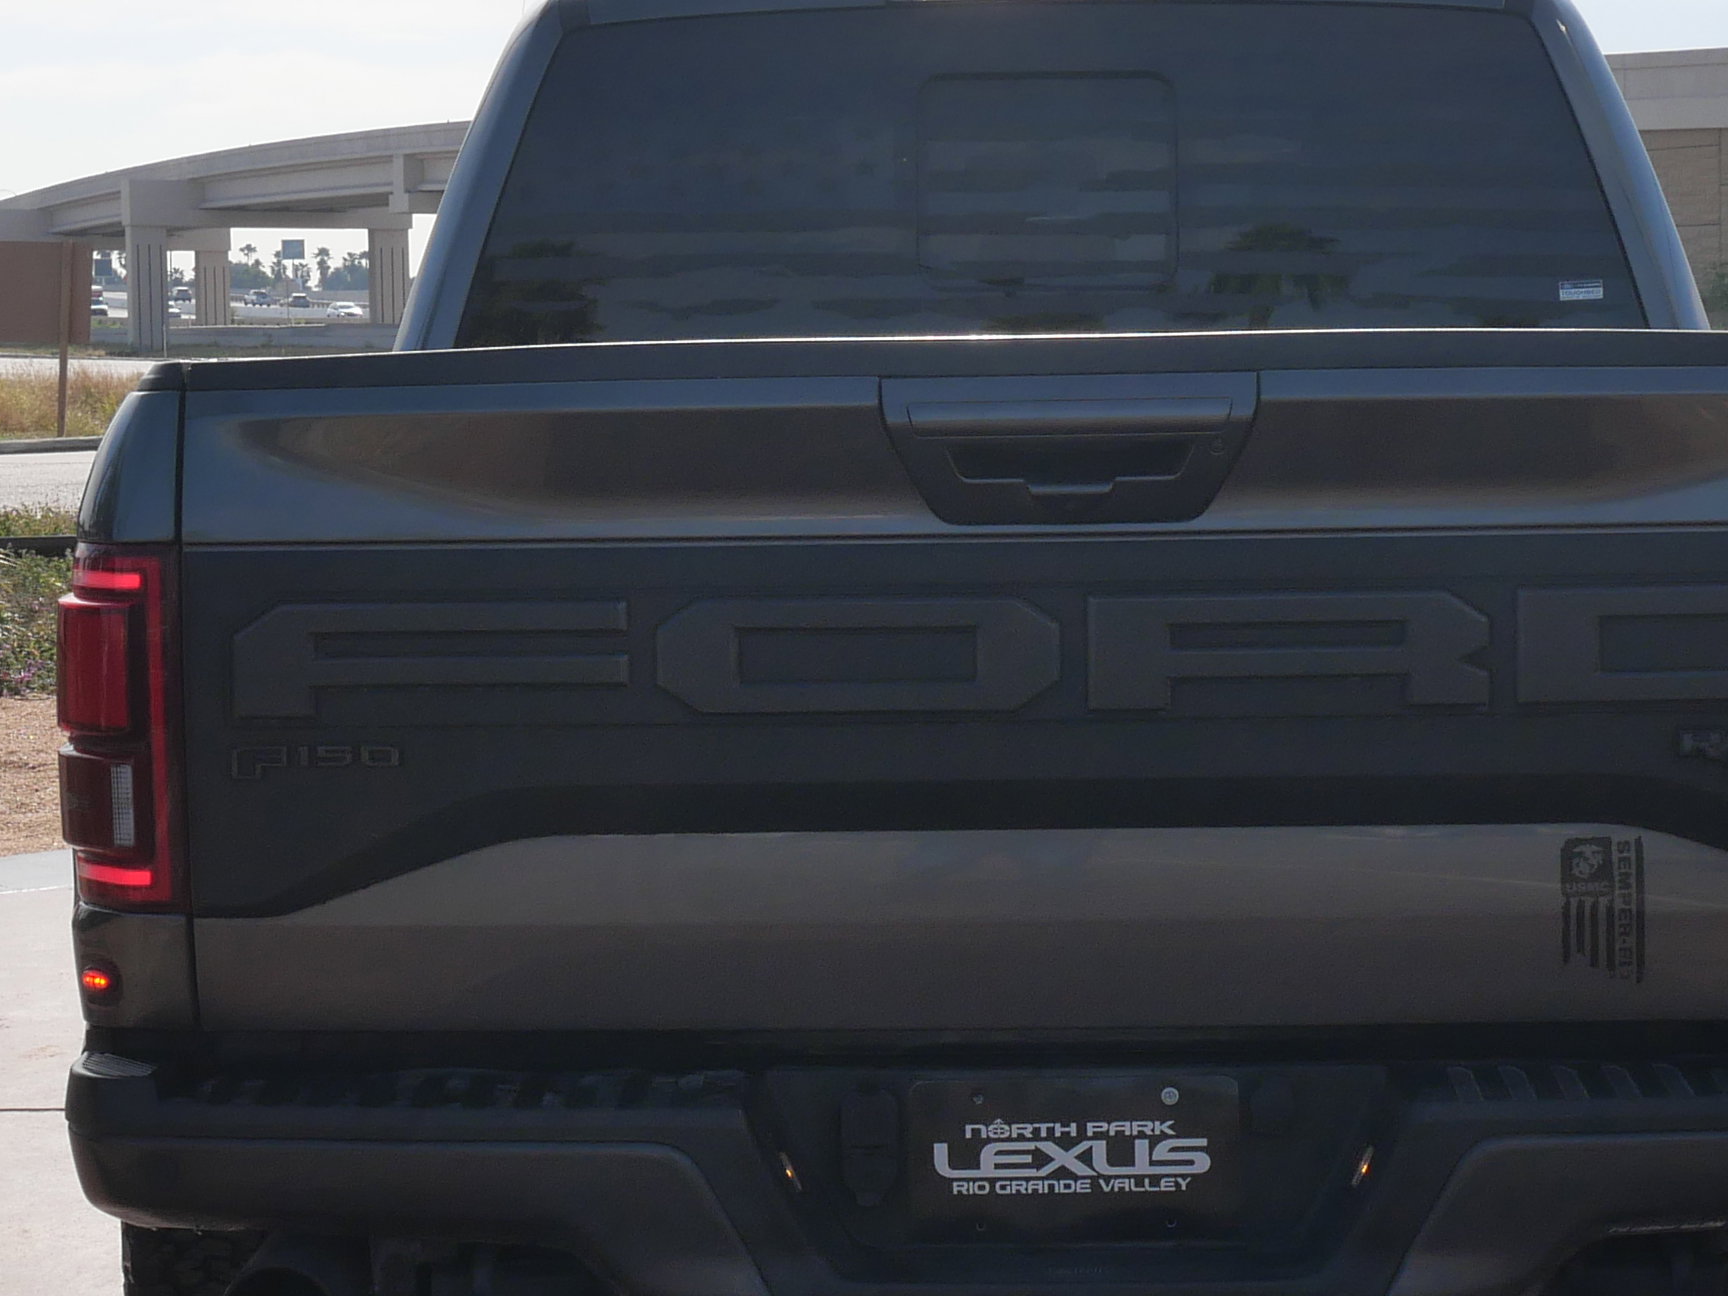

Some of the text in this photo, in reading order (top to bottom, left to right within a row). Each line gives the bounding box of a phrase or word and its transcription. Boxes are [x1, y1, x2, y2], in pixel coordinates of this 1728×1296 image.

[965, 1120, 1176, 1139] NORTH PARK
[933, 1138, 1211, 1178] LEXUS
[953, 1176, 1192, 1195] RIO GRANDE VALLEY
